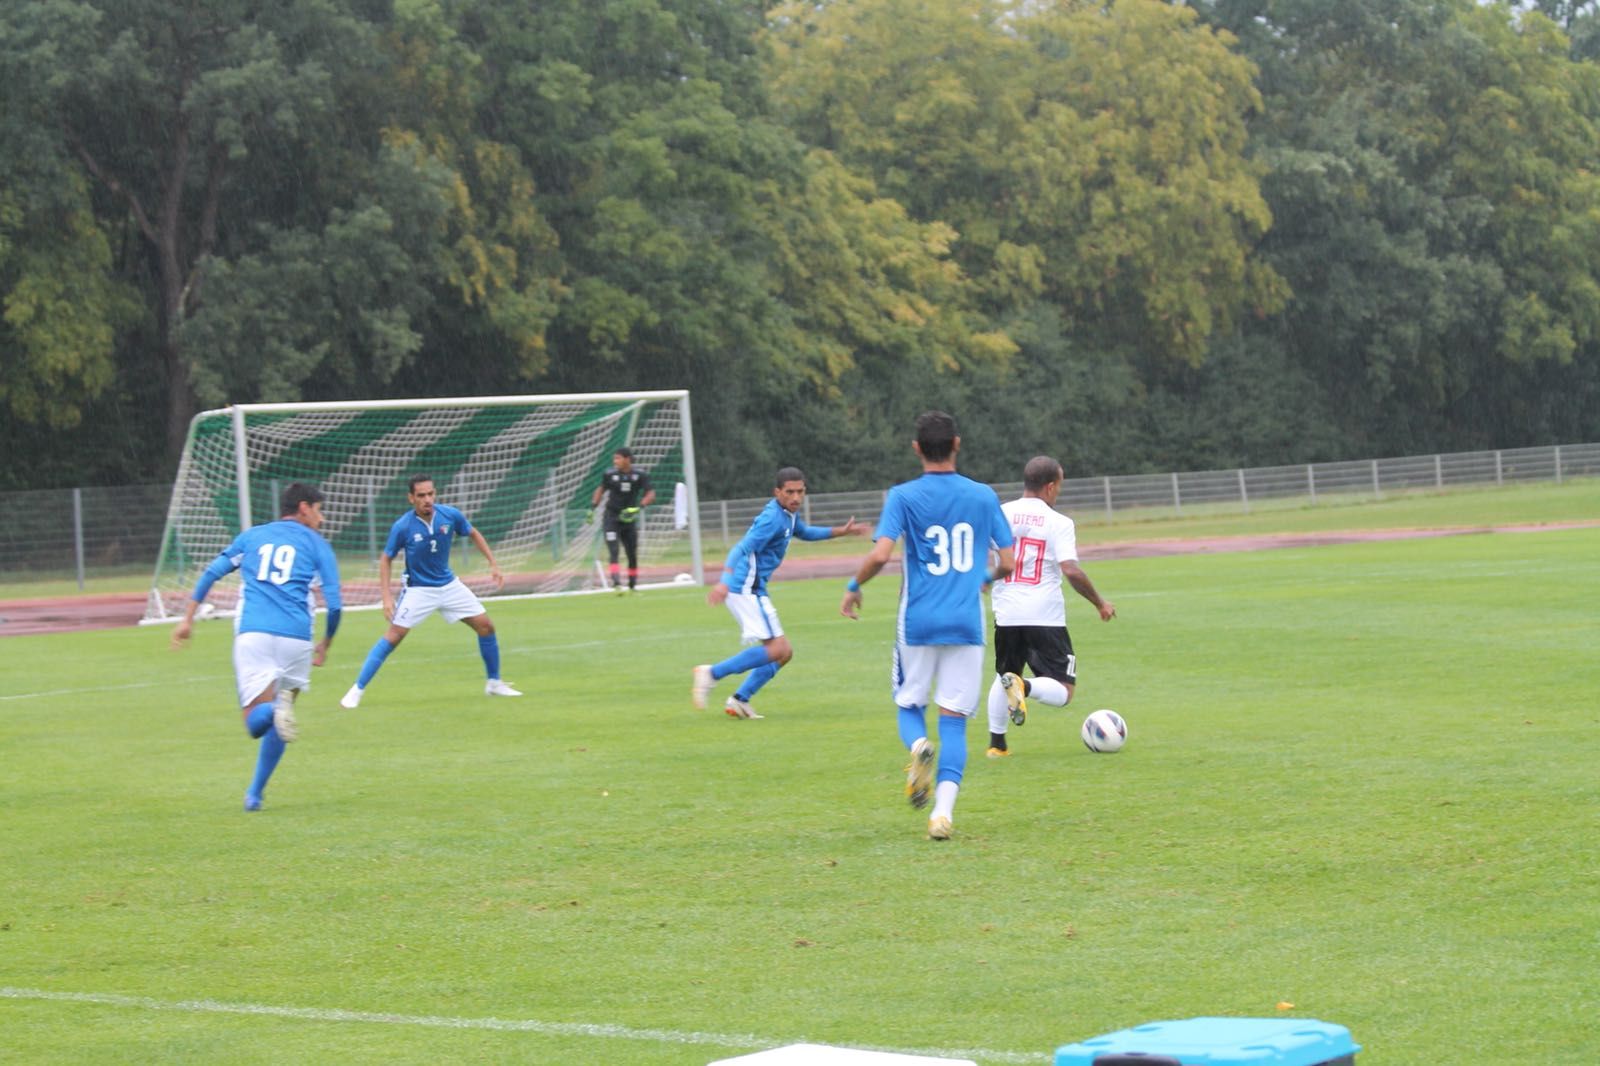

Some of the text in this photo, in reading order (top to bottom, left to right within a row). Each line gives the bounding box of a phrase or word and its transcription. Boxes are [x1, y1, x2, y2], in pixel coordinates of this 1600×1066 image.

[256, 543, 296, 585] 19
[430, 539, 438, 552] 2
[925, 522, 974, 576] 30
